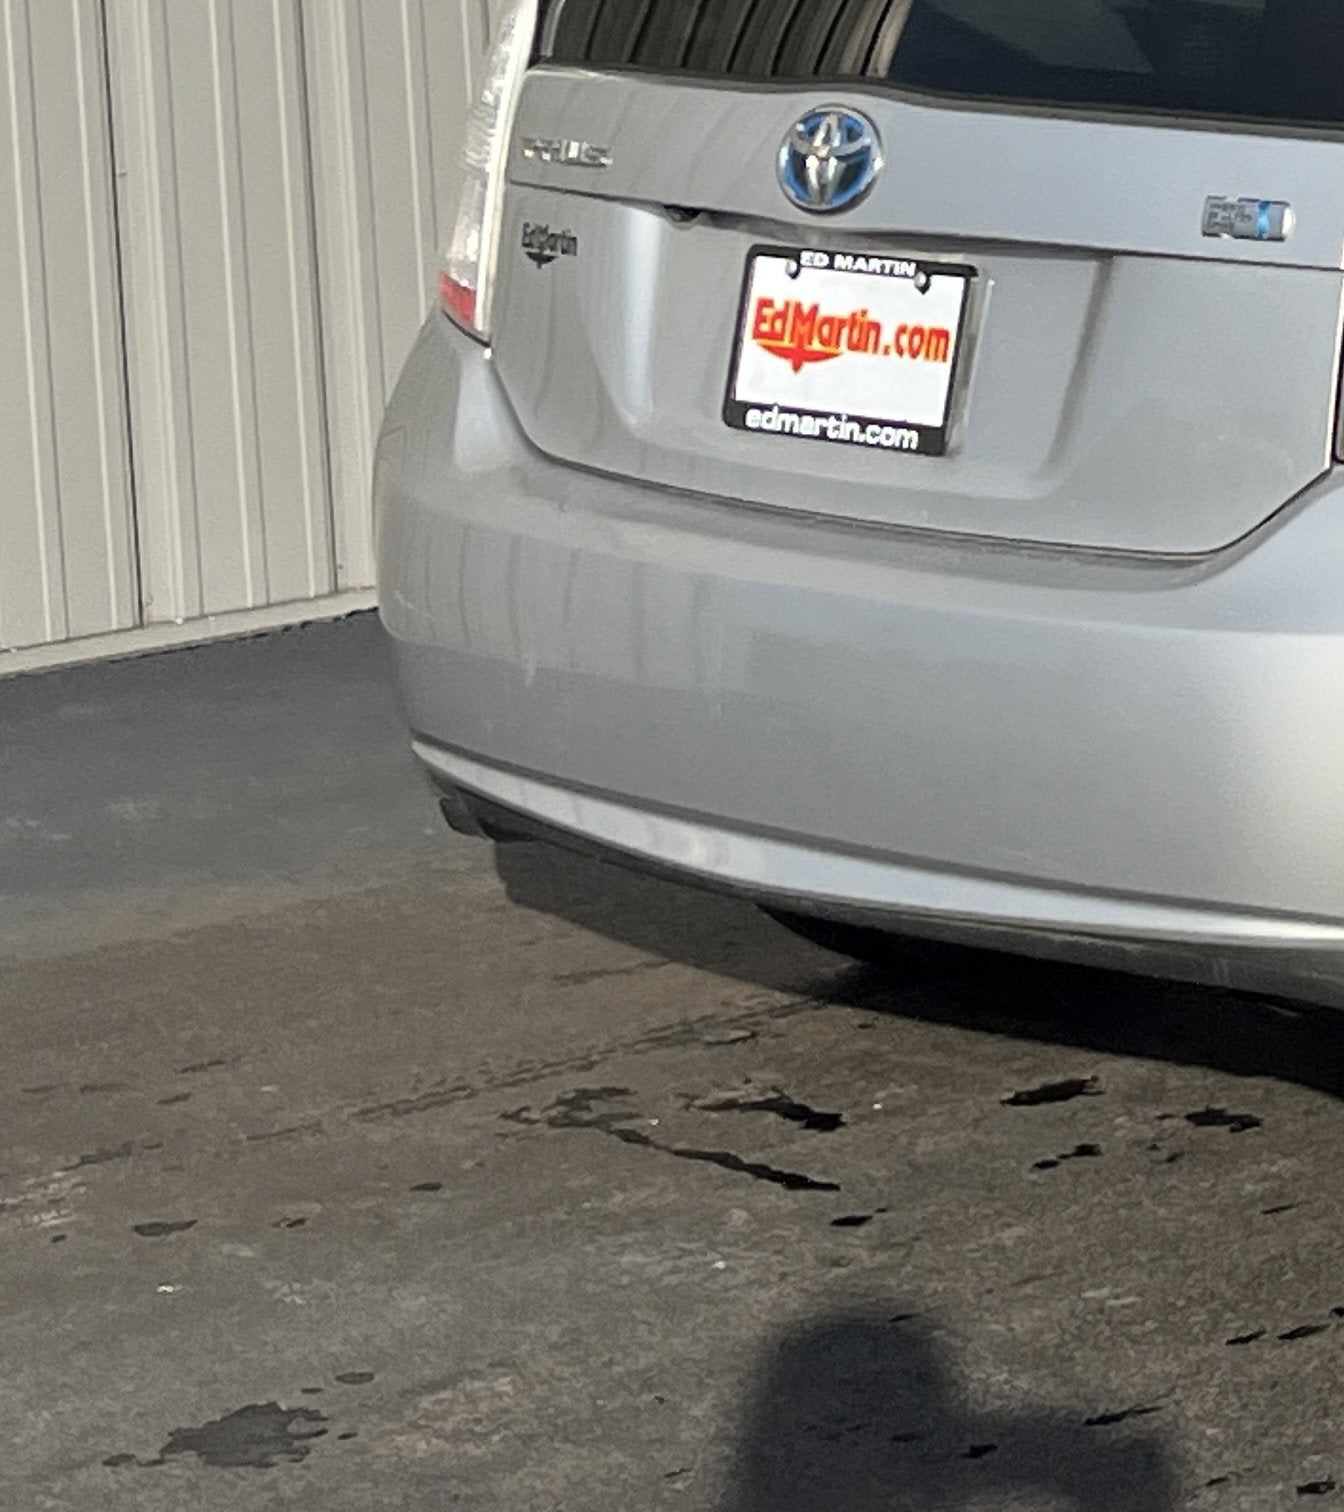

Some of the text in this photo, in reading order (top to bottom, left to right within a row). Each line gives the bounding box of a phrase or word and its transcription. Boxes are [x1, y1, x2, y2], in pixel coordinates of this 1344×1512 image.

[800, 251, 917, 277] ED MARTIN
[752, 297, 950, 363] EdMartin.com
[745, 405, 919, 450] edmartin.com
